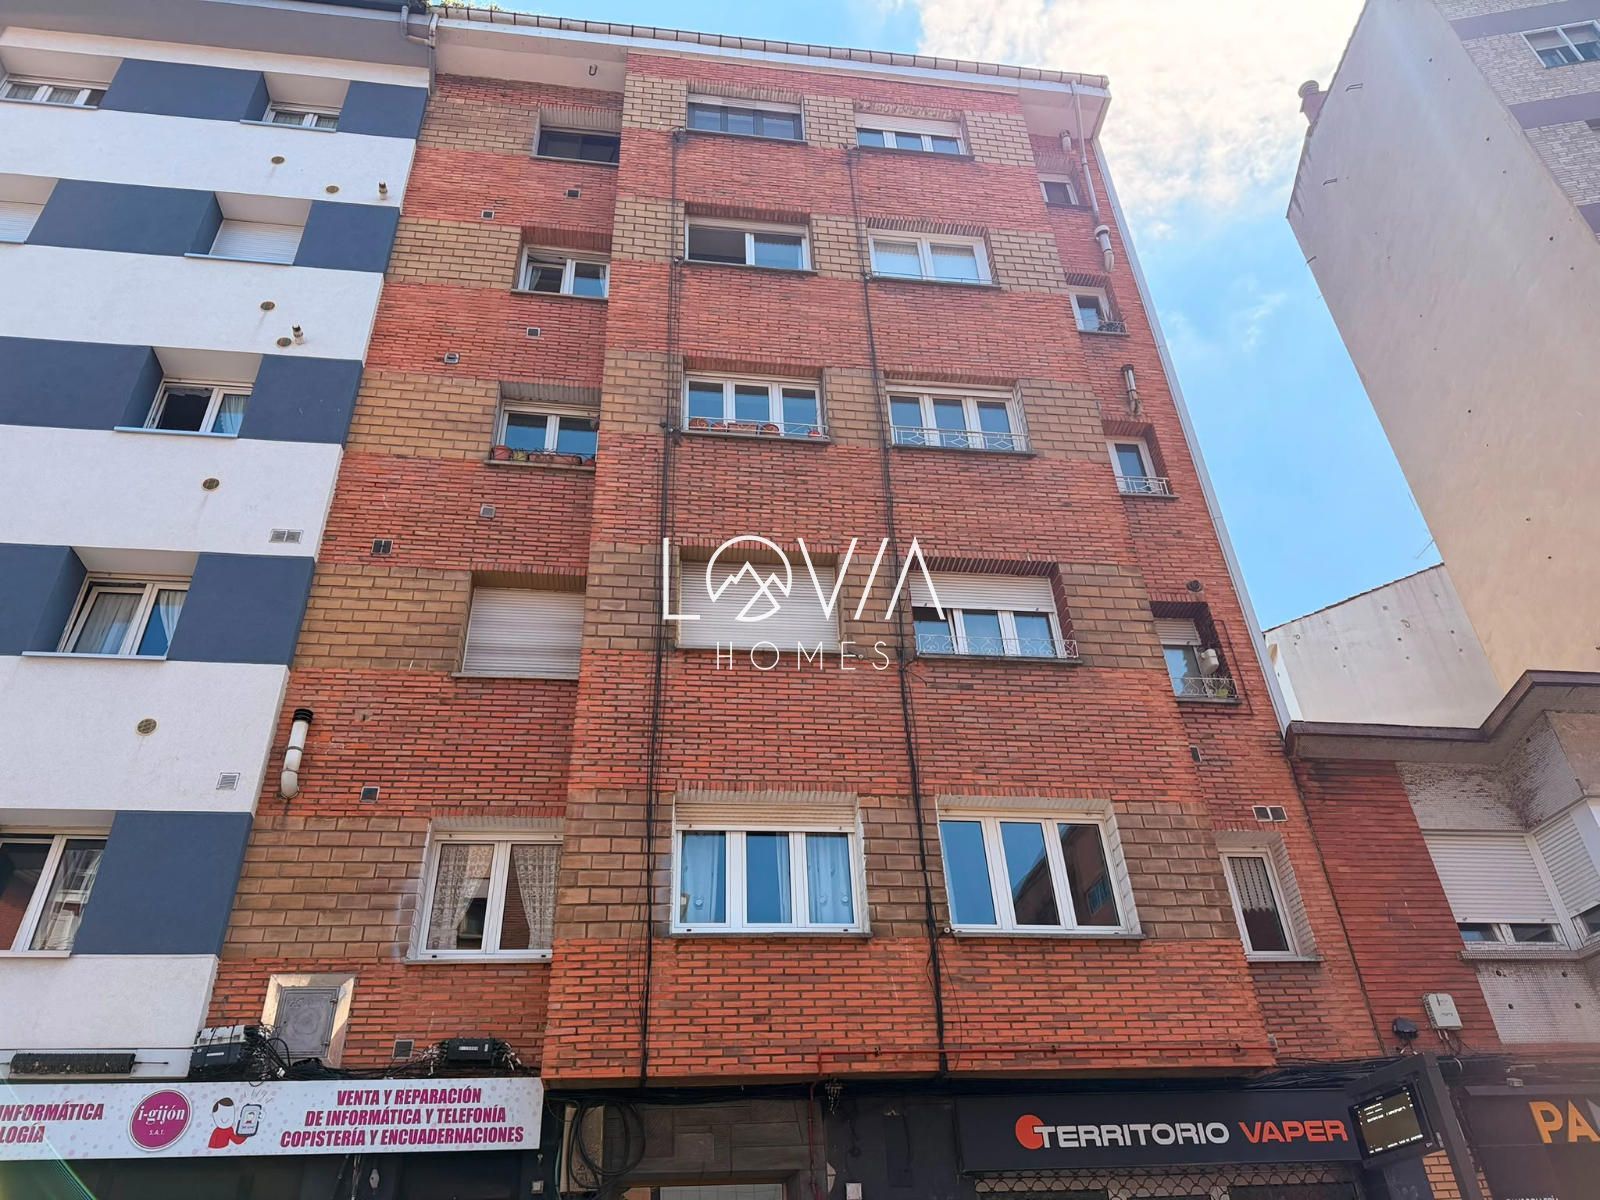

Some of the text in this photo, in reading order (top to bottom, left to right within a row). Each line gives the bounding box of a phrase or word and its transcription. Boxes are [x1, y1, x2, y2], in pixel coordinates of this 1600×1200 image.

[337, 1085, 482, 1106] VENTA Y REPARACIÓN
[138, 1105, 185, 1125] i-gijón
[305, 1105, 506, 1126] DE INFORMÁTICA Y TELEFONÍA
[1528, 1099, 1600, 1143] PA
[280, 1126, 524, 1147] COPISTERÍA Y ENCUADERNACIONES
[1033, 1120, 1349, 1148] TERRITORIO VAPER
